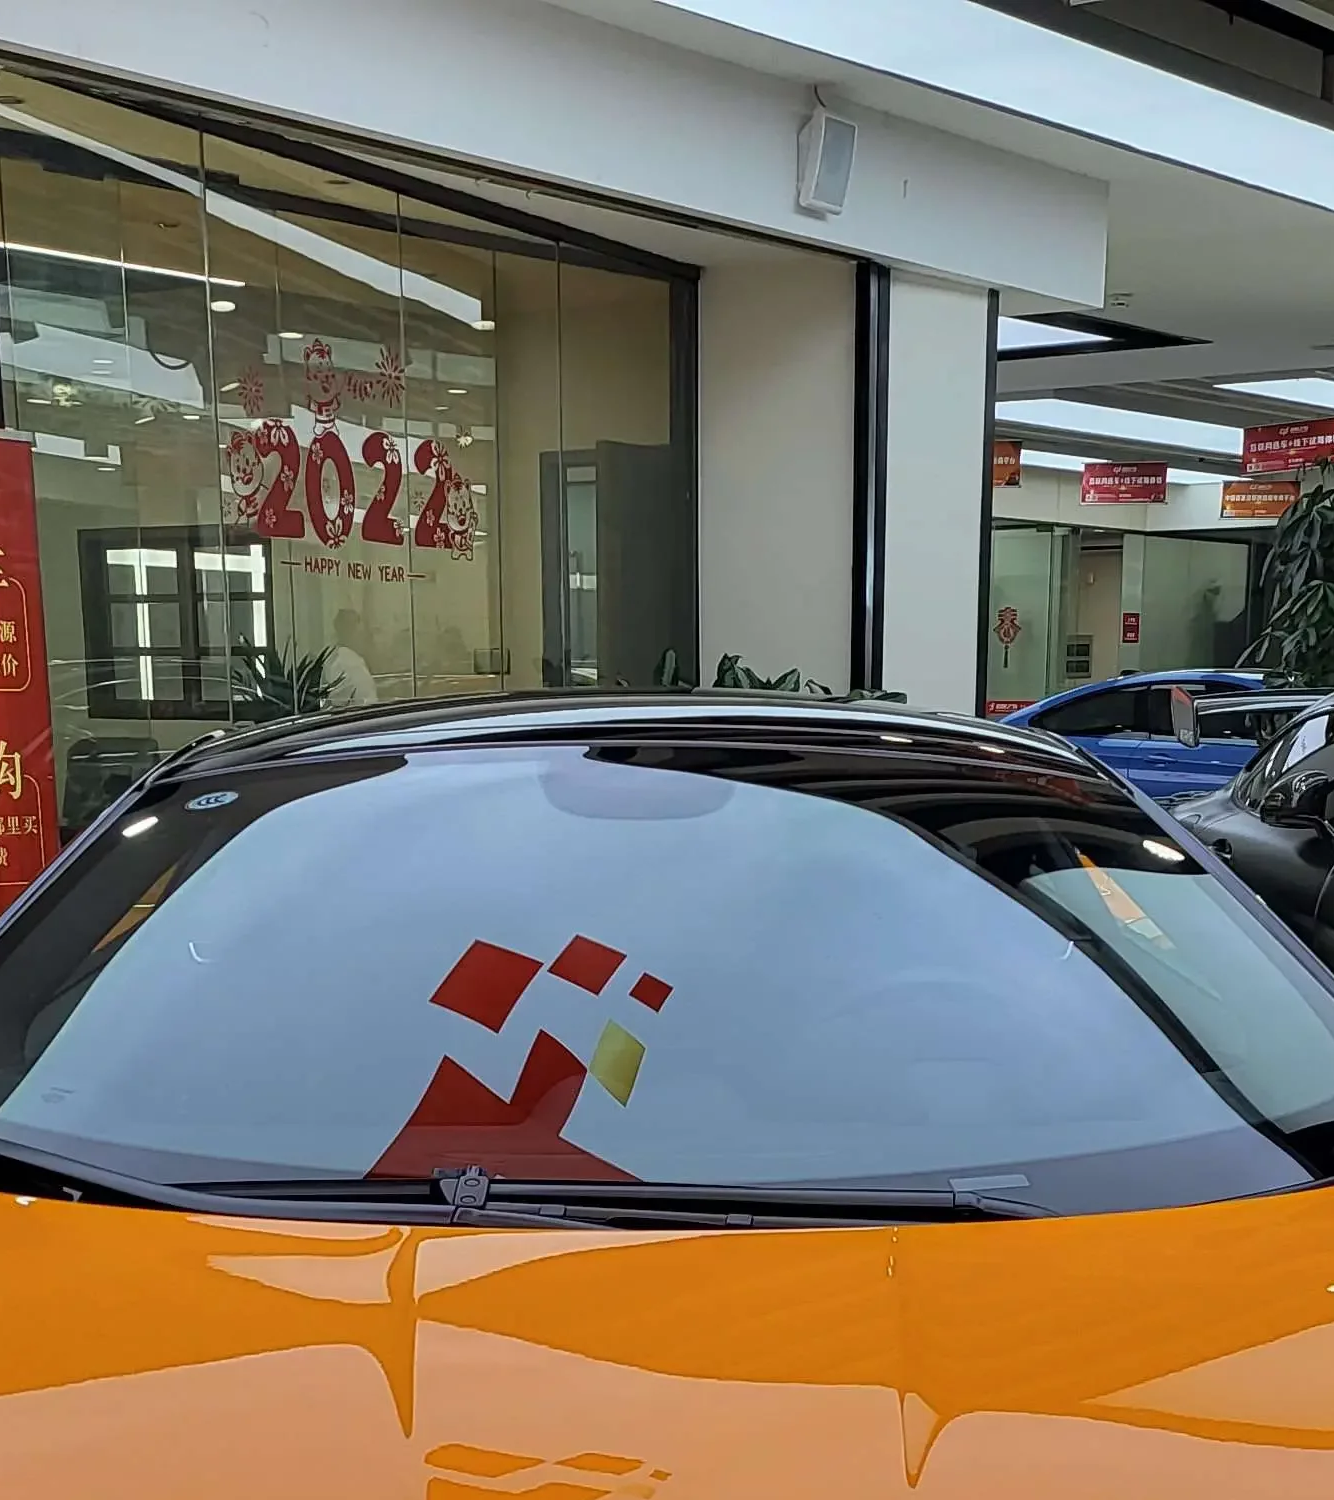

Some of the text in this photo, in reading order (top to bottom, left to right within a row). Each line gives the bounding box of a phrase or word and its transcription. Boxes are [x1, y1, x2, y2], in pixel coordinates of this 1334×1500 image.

[253, 418, 457, 550] 2022
[304, 557, 405, 582] HAPPY NEW YEAR
